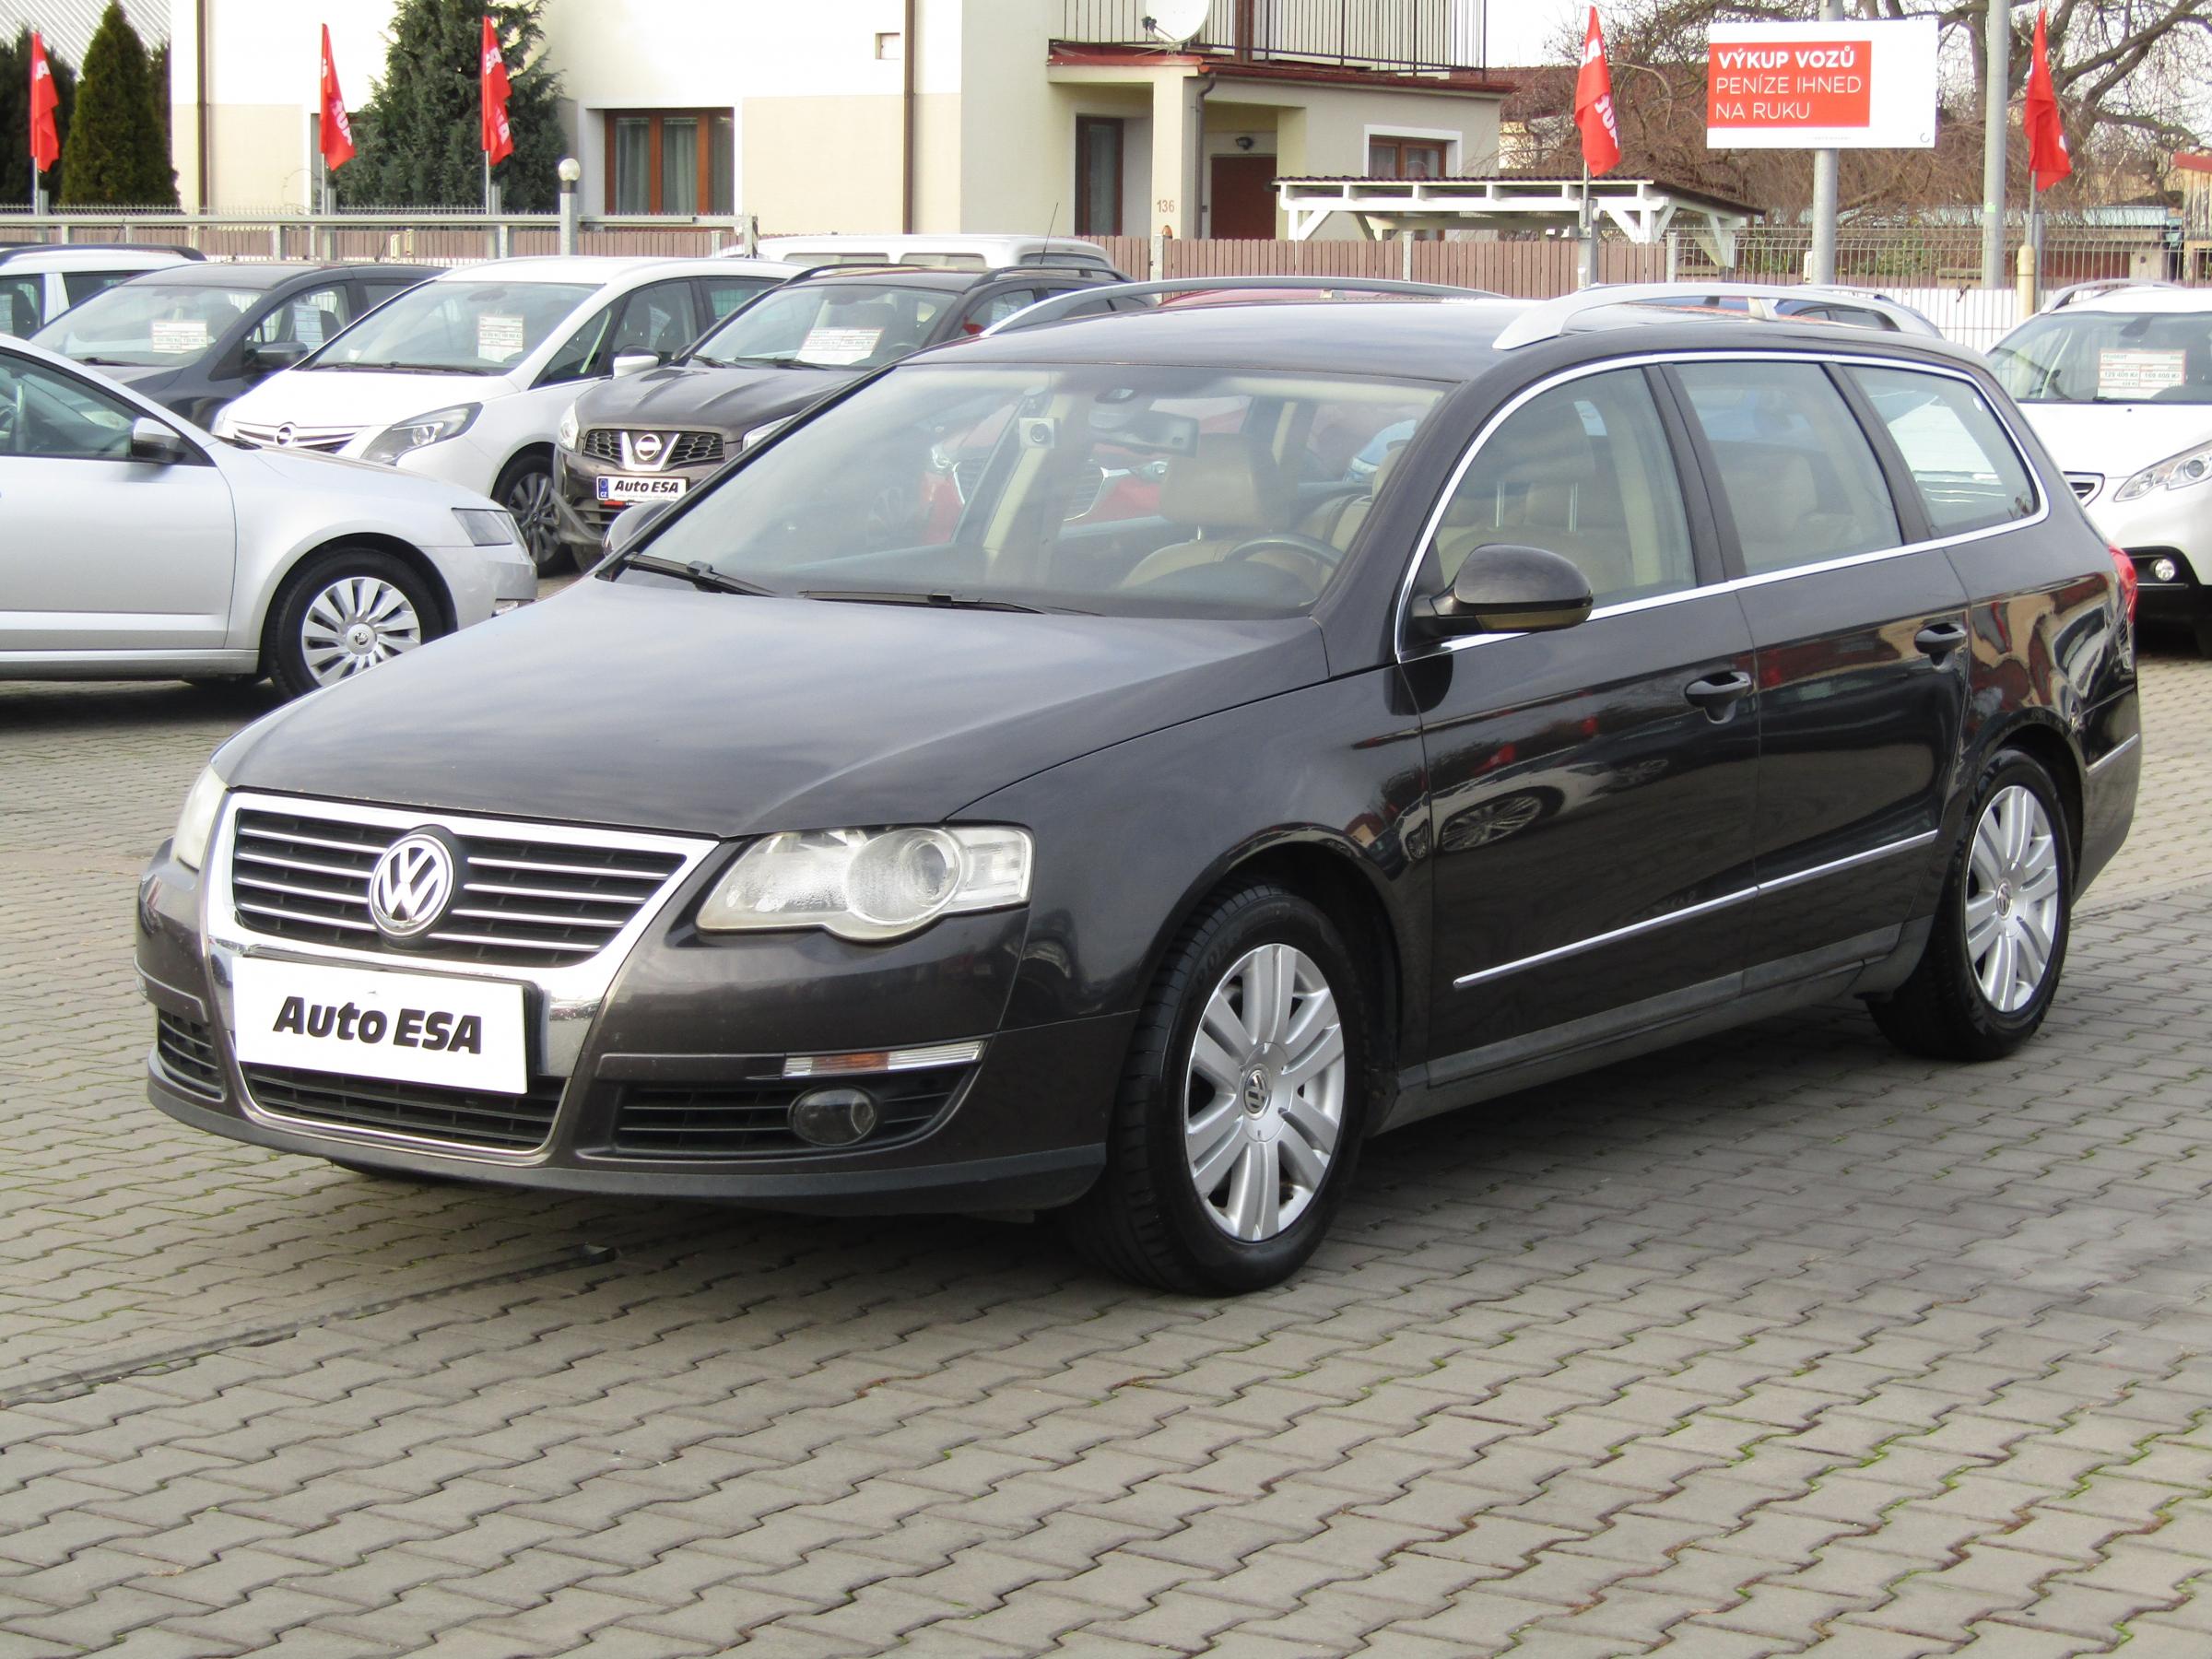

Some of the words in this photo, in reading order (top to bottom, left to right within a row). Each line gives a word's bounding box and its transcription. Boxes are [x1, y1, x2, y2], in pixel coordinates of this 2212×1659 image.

[1717, 48, 1789, 69] VÝKUP
[1794, 45, 1855, 68] VOZŮ
[1716, 74, 1789, 95] PENÍZE
[1796, 76, 1862, 93] IHNED
[1715, 102, 1746, 119] NA
[1753, 101, 1811, 119] RUKU
[1157, 199, 1175, 213] 136
[614, 480, 650, 493] Auto
[651, 481, 679, 493] ESA
[272, 995, 388, 1044] Auto
[393, 1008, 482, 1054] ESA
